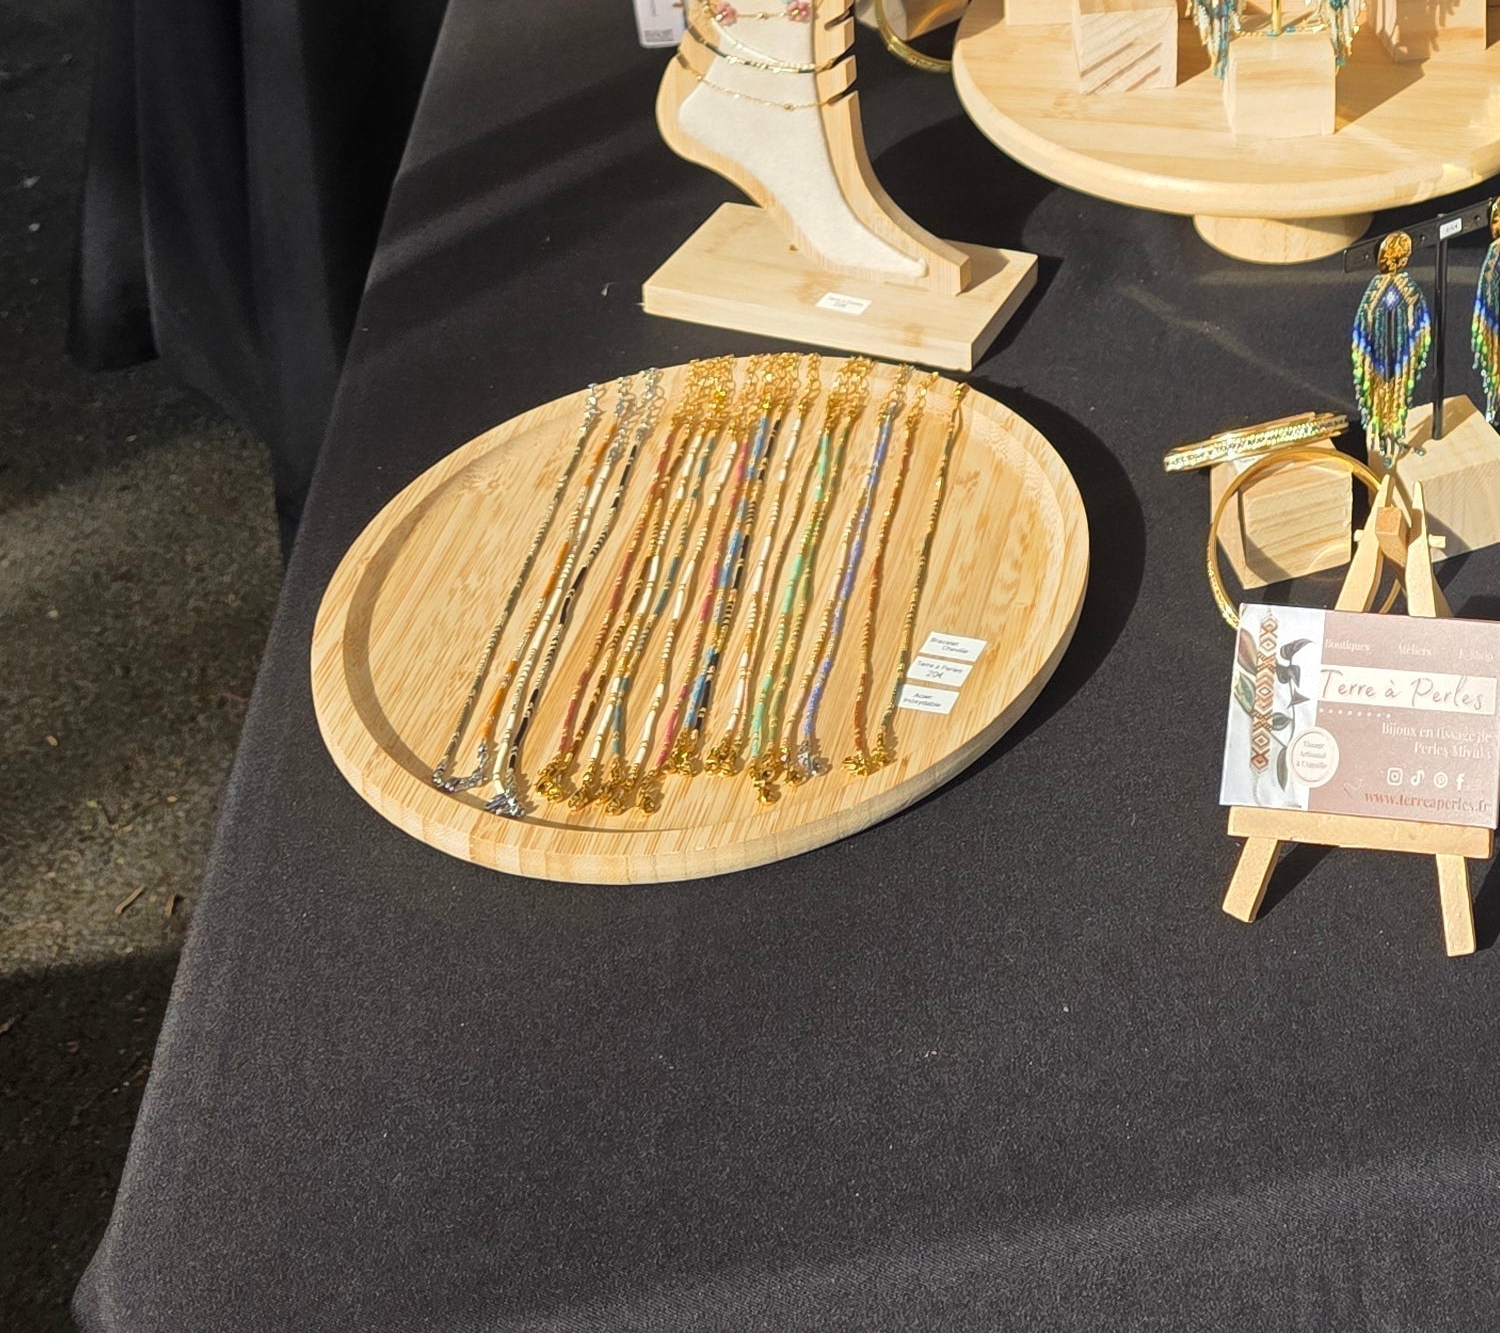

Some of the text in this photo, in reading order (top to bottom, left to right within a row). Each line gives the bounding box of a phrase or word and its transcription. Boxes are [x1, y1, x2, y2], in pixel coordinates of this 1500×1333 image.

[1325, 638, 1370, 652] Boutiques
[1397, 644, 1432, 656] Ateliers
[1321, 669, 1483, 711] Terre à Perles
[1382, 722, 1416, 739] Bijoux
[1420, 728, 1433, 738] en
[1437, 726, 1475, 744] tissage
[1414, 742, 1449, 758] Perles
[1365, 791, 1489, 814] www.terreaperles.fr
